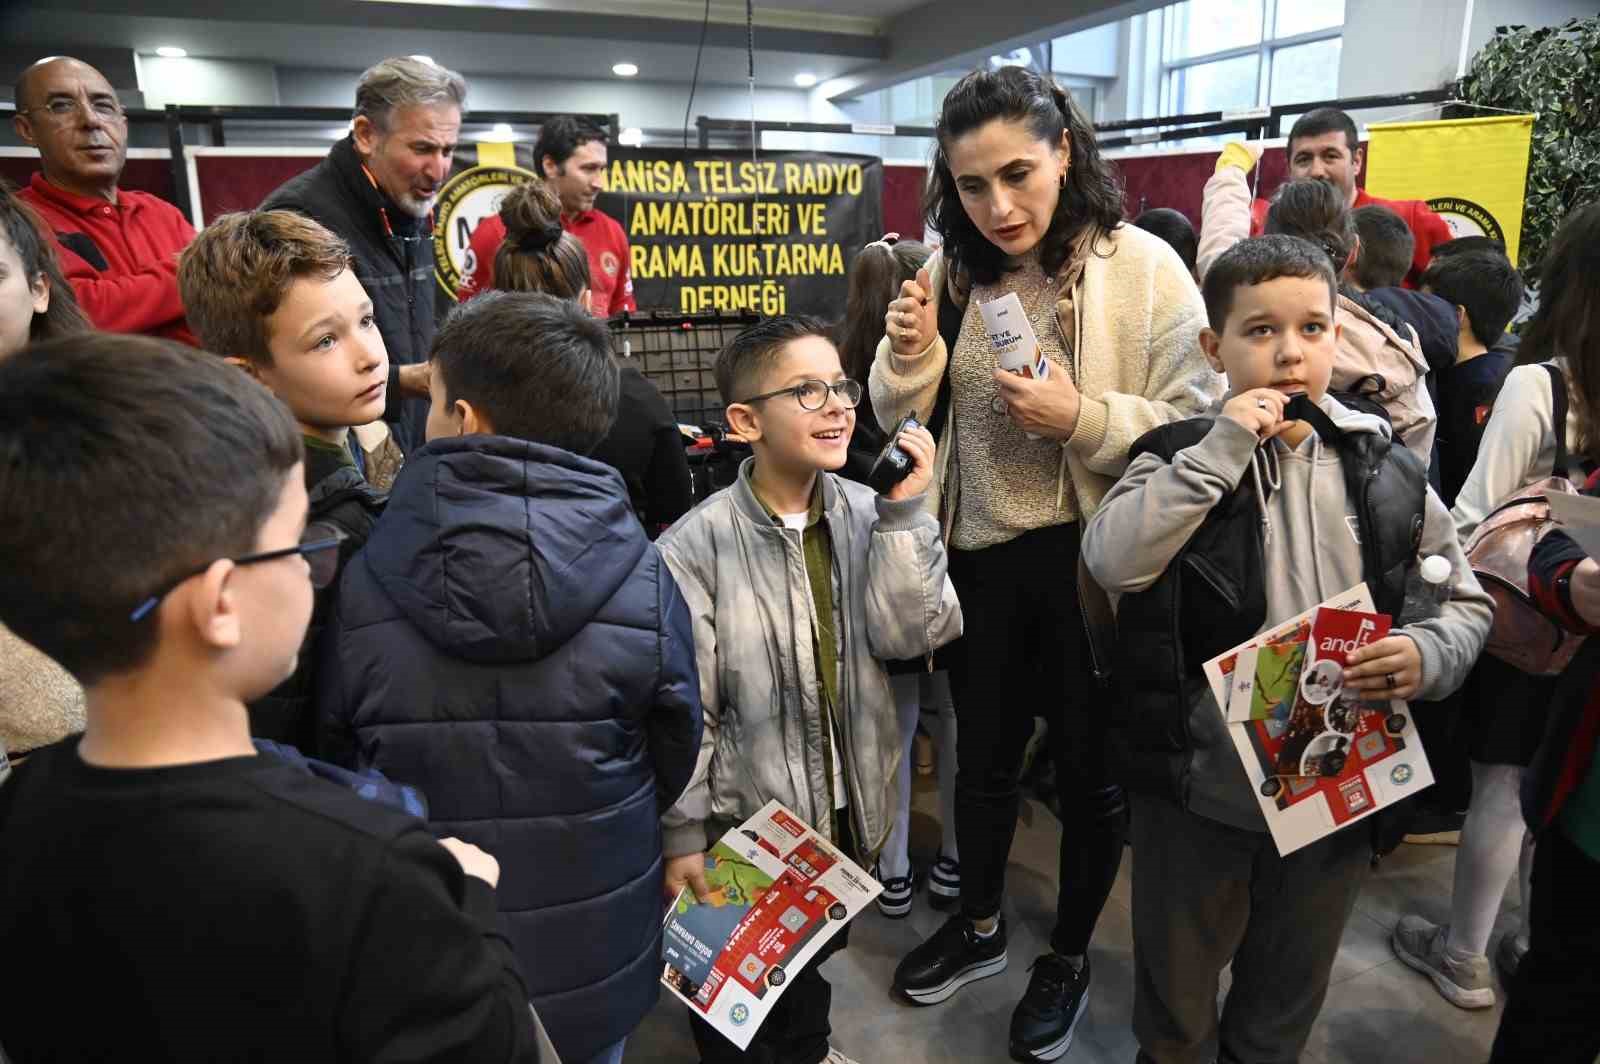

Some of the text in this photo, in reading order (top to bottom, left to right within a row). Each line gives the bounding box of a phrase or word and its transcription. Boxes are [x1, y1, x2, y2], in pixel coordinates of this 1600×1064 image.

[694, 160, 779, 194] TELSİZ
[784, 163, 863, 195] RADYO
[630, 195, 827, 236] AMATÖRLERİ VE
[631, 243, 845, 278] RAMA KURTARMA
[681, 280, 786, 315] DERNEĞİ
